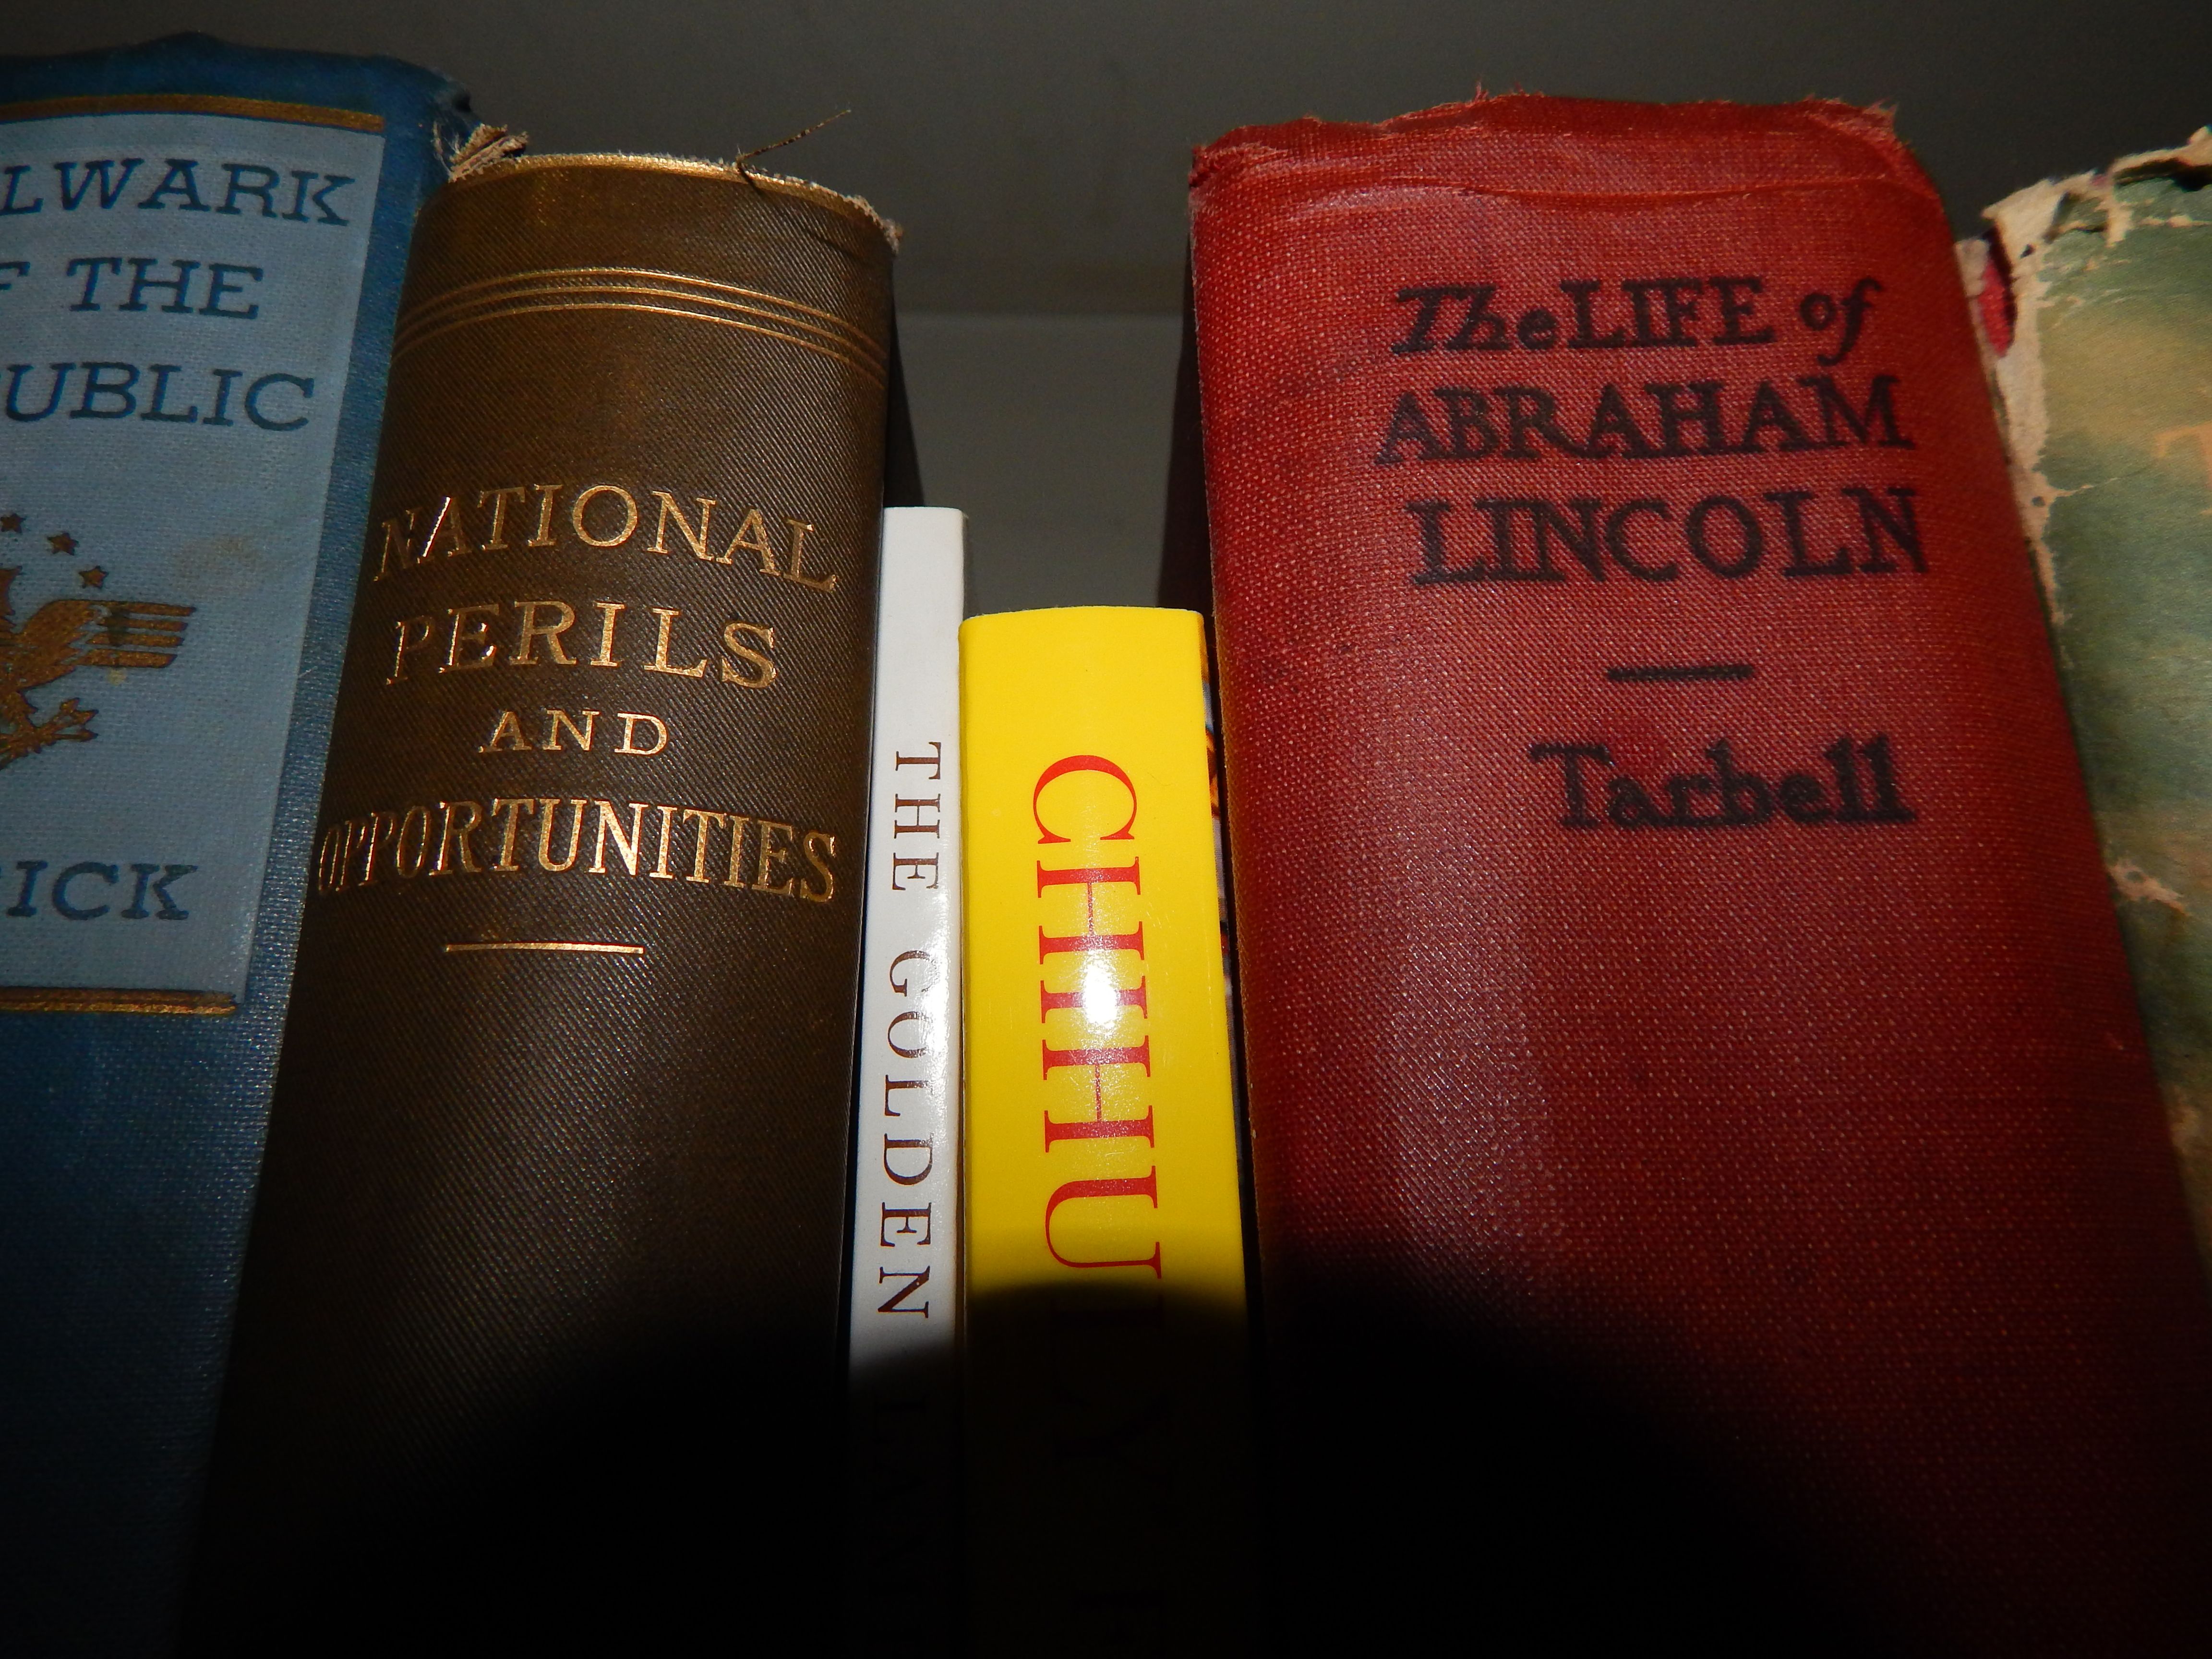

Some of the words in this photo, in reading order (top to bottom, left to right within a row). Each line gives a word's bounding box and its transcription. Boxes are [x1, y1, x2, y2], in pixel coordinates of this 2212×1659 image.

[0, 158, 355, 226] LWARK
[66, 257, 264, 320] THE
[1798, 276, 1886, 366] of
[6, 361, 315, 431] UBLIC
[1373, 373, 1916, 467] ABRAHAM
[373, 483, 837, 594] NATIONAL
[1404, 486, 1928, 586] LINCOLN
[385, 599, 778, 689] PERILS
[478, 709, 668, 756] AND
[891, 741, 942, 892] THE
[1528, 733, 1917, 831] Tarbell
[7, 860, 198, 920] ICK
[317, 797, 836, 904] OPPORTUNITIES
[877, 949, 939, 1319] GOLDEN
